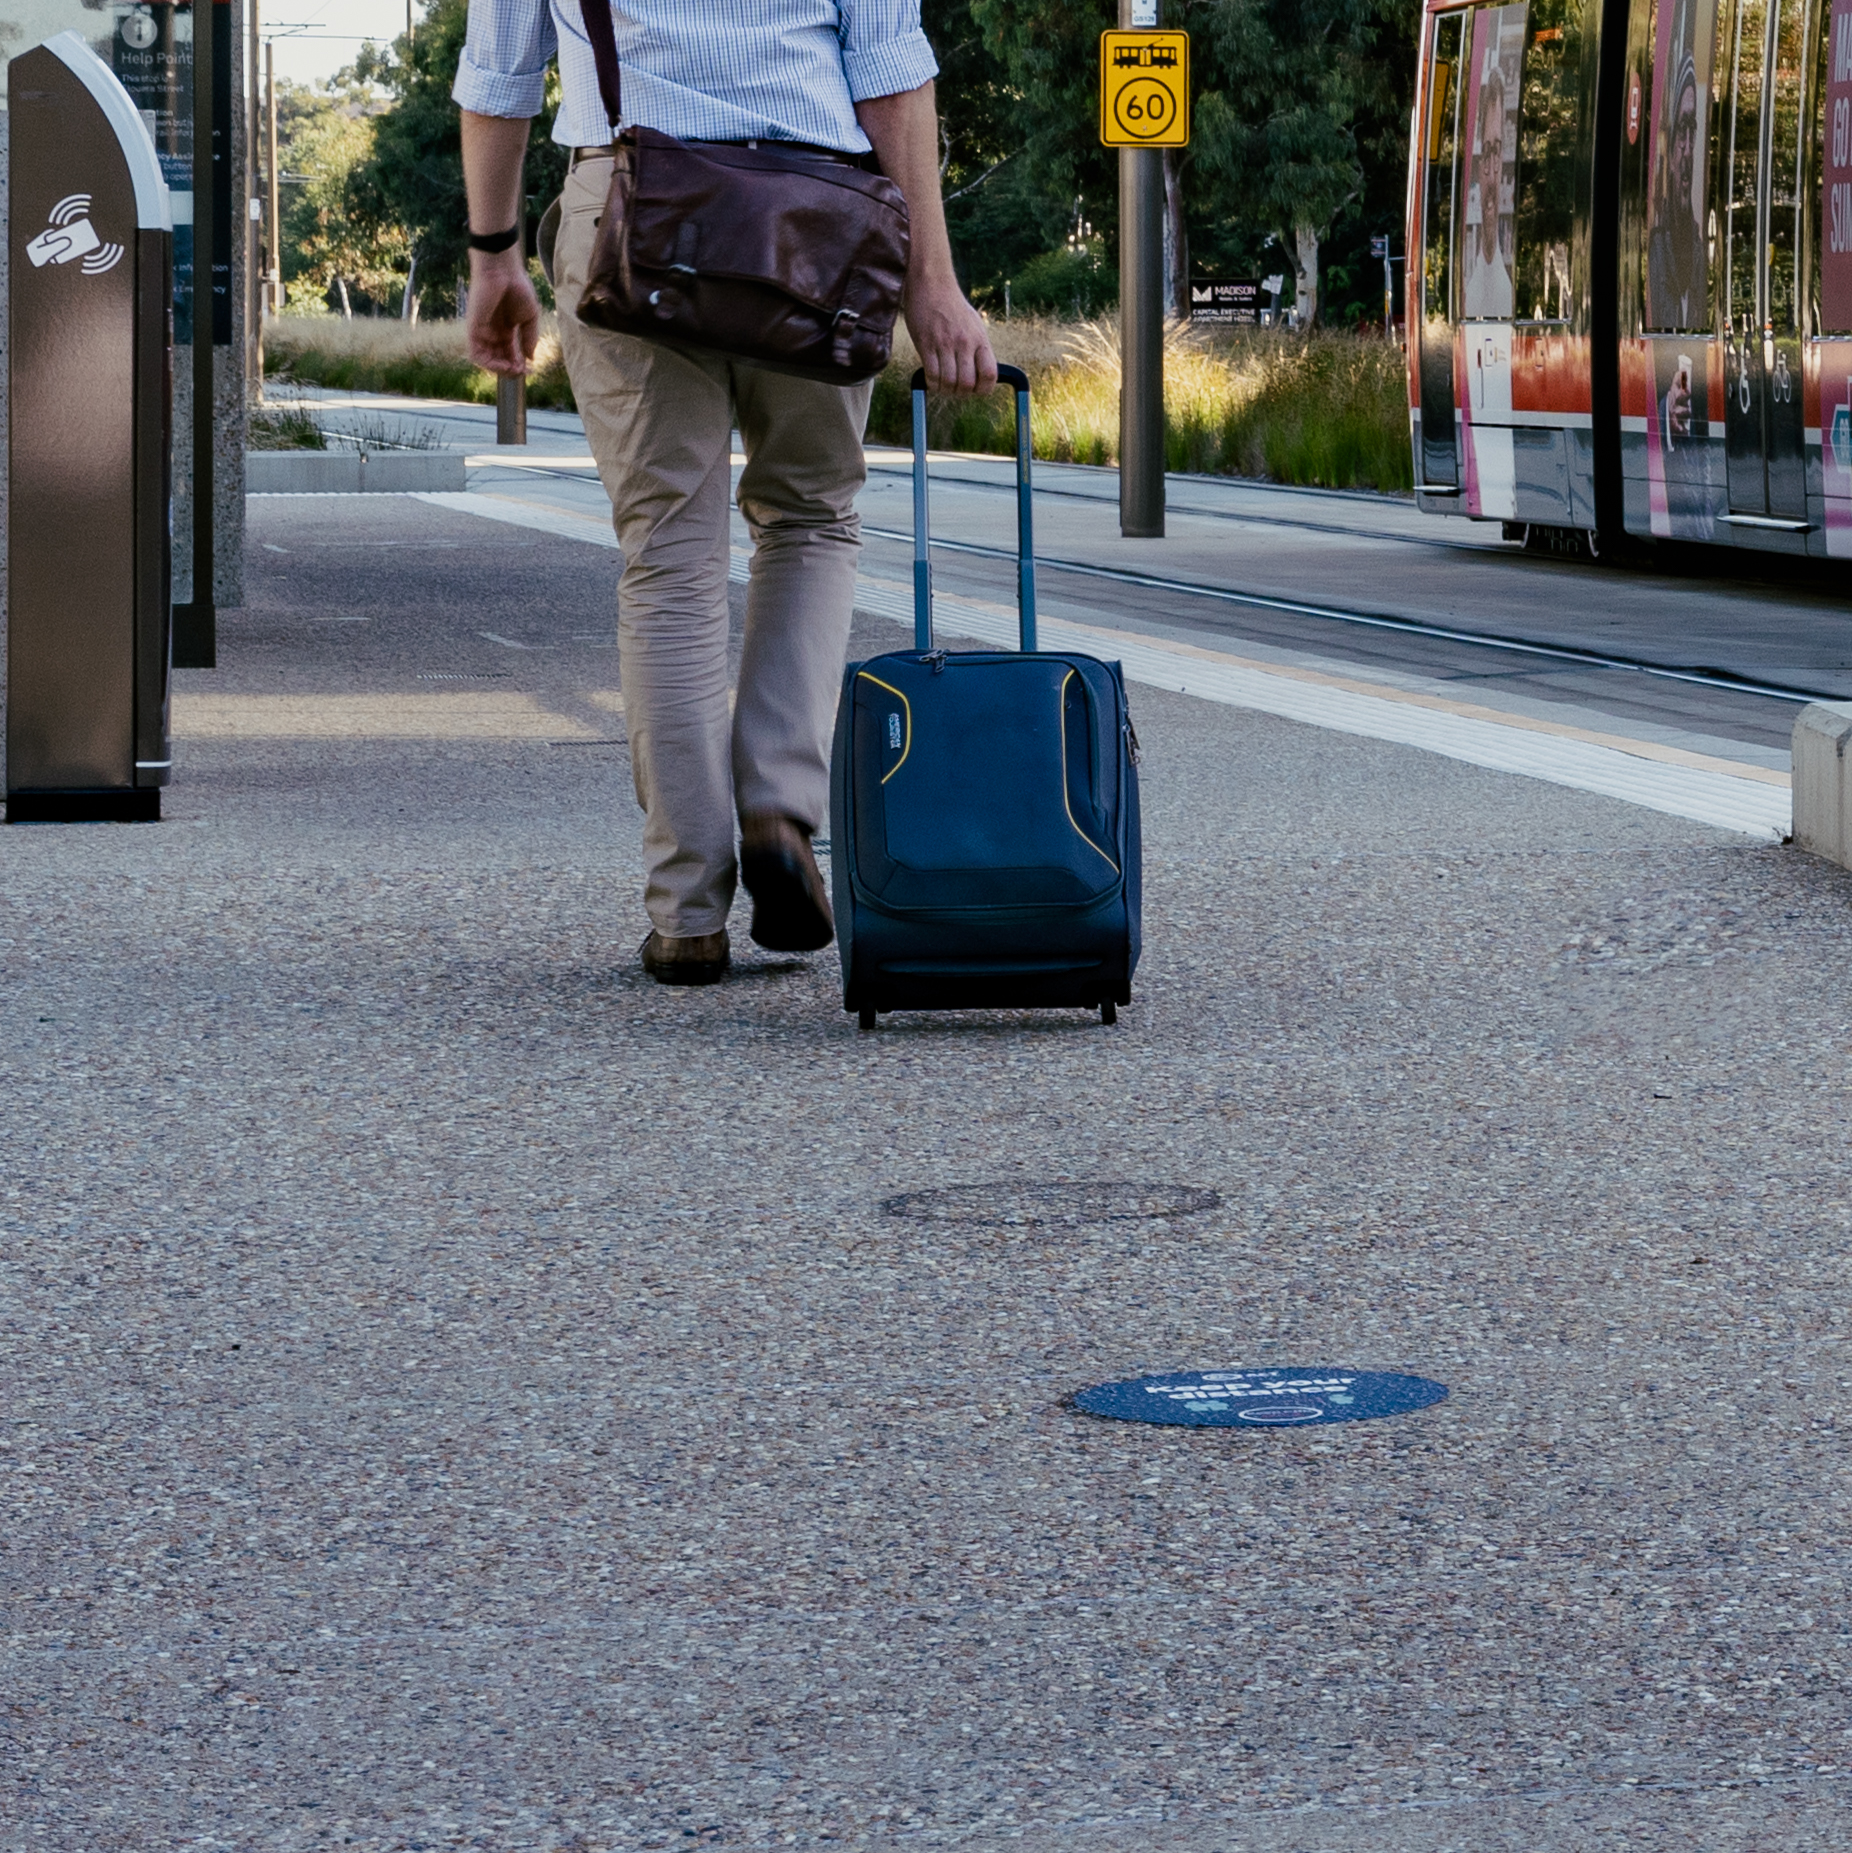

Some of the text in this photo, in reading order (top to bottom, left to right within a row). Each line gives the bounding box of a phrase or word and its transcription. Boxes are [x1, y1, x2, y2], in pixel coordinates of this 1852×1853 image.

[121, 50, 193, 68] Help Point
[1127, 93, 1165, 121] 60
[1832, 97, 1850, 167] GO
[1214, 285, 1257, 296] MADISON
[1145, 1377, 1357, 1393] Keep your
[1168, 1386, 1349, 1399] distance
